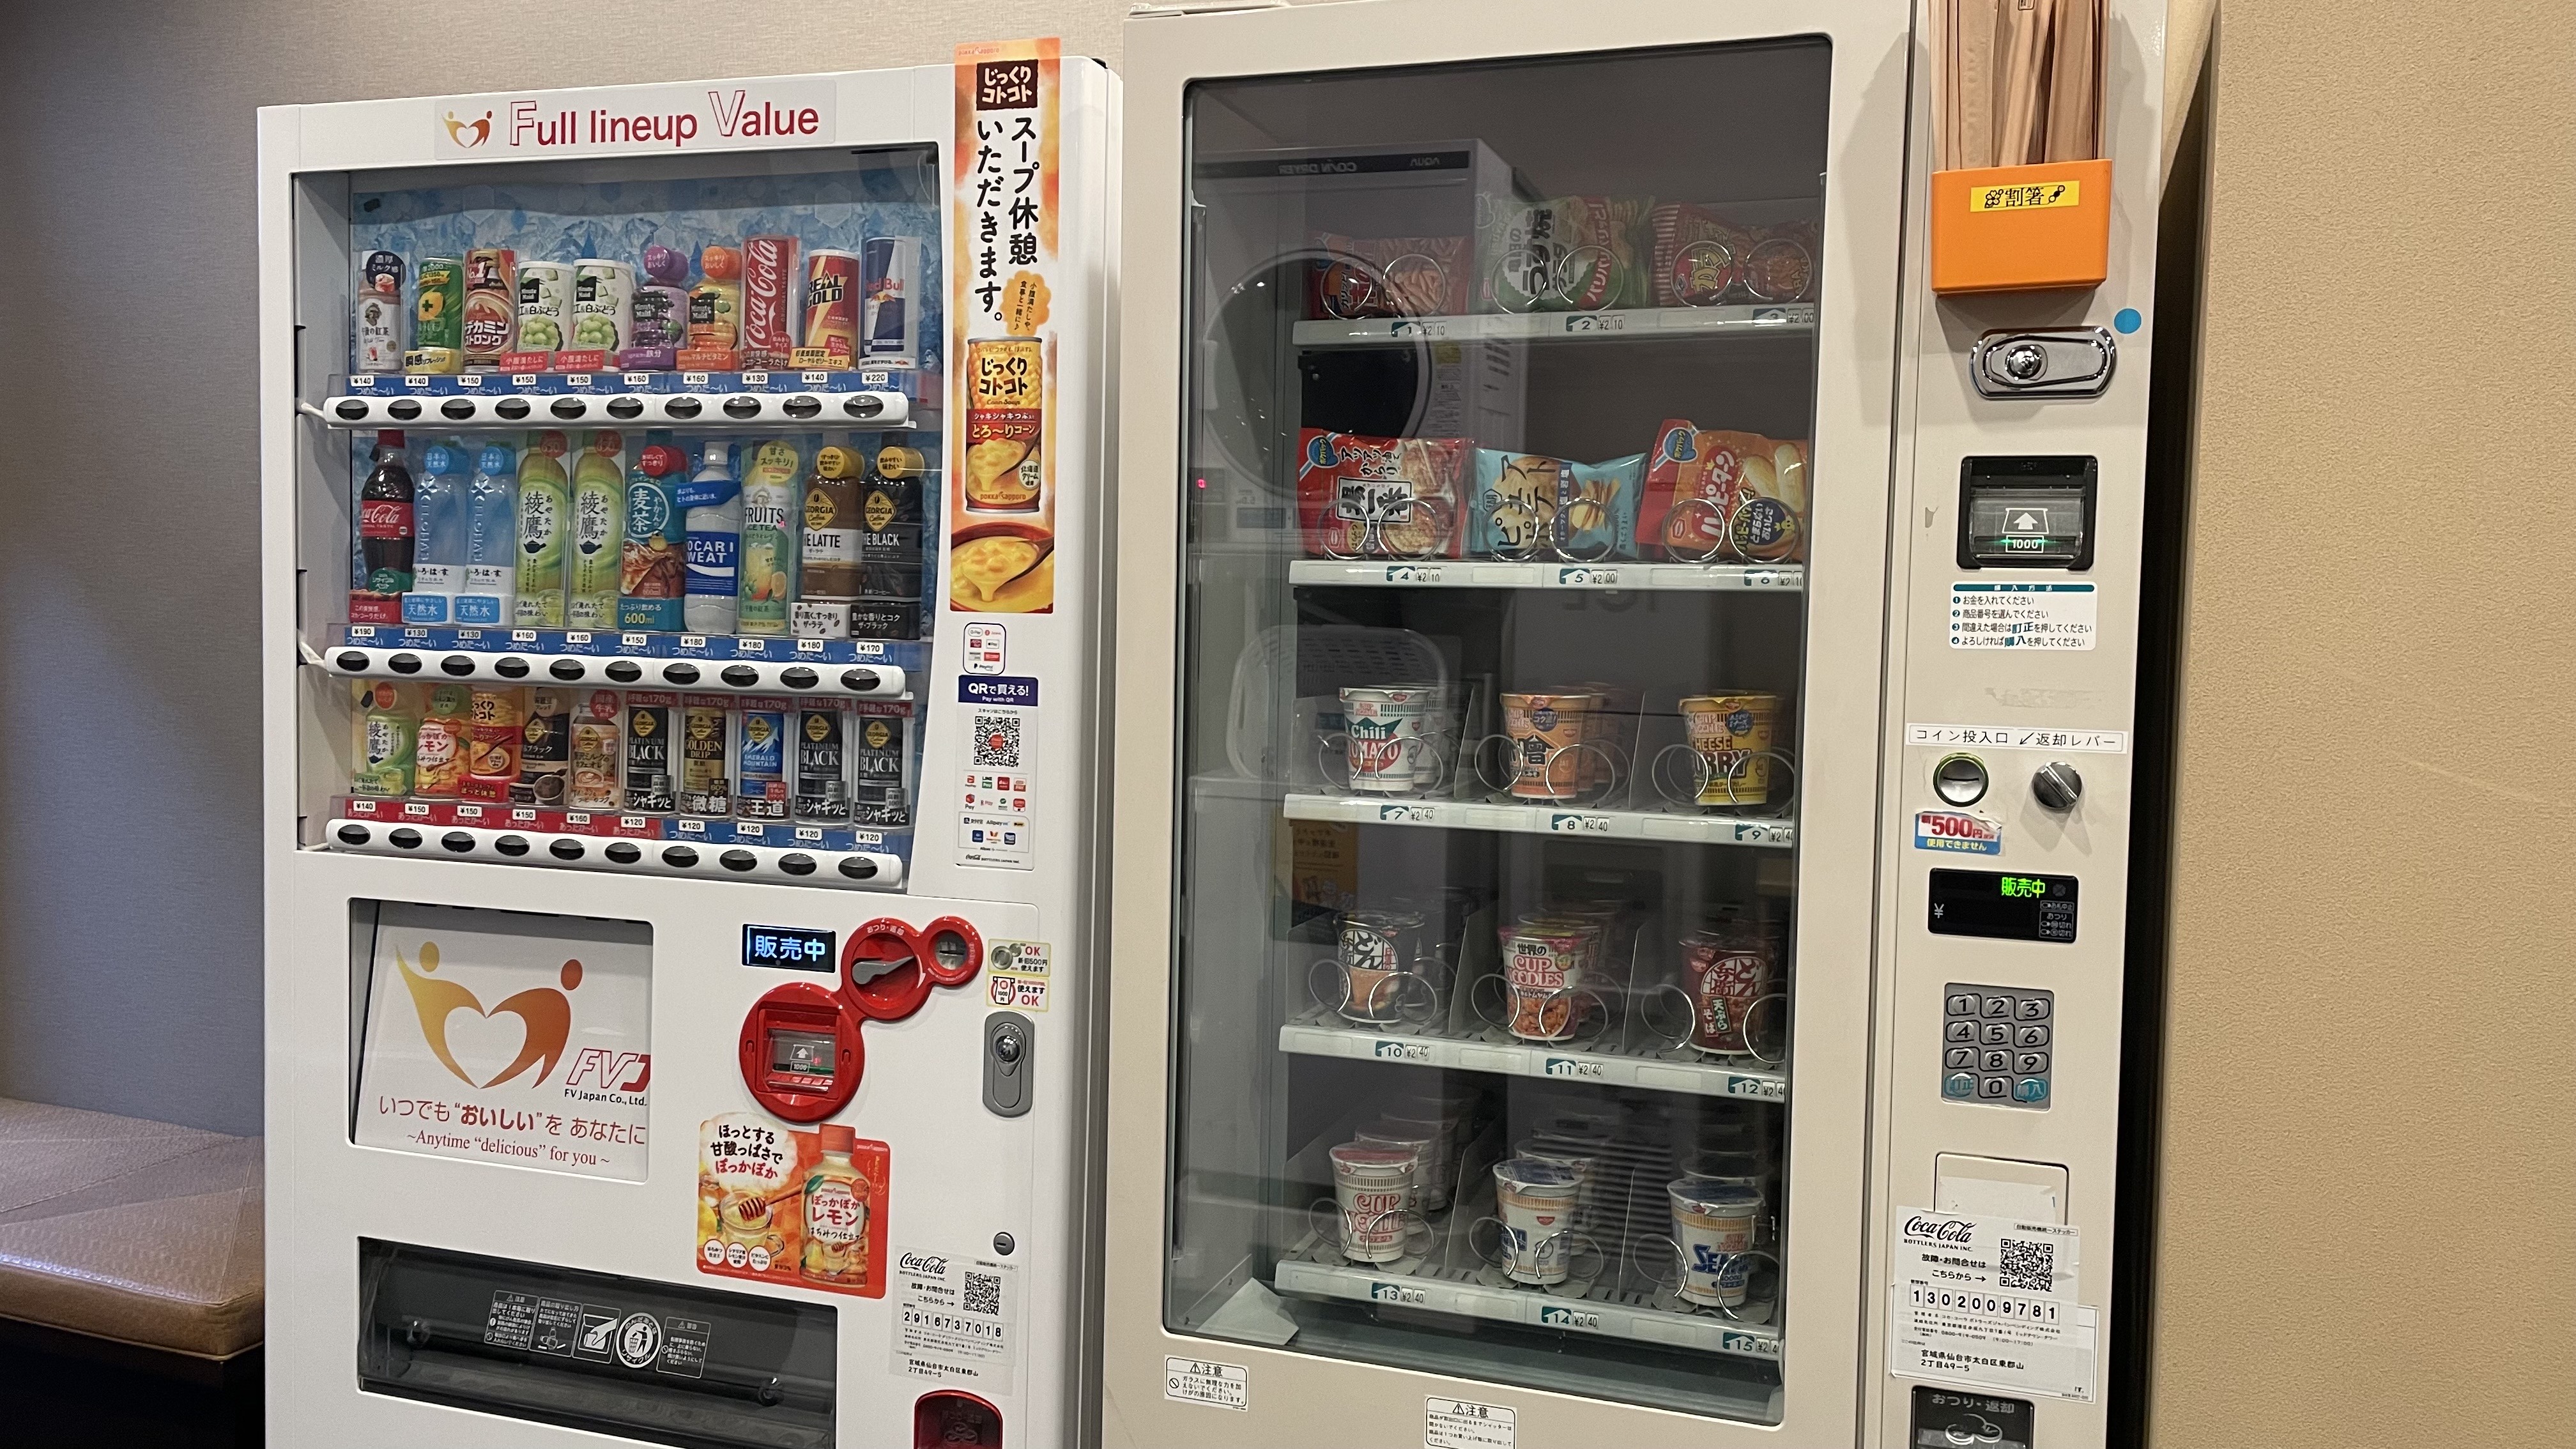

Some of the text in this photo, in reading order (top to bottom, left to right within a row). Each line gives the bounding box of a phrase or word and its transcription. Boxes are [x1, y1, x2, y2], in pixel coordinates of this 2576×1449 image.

[984, 66, 1032, 86] じっくり
[981, 84, 1032, 104] コトコト
[509, 89, 820, 148] Full lineup Value
[1008, 116, 1040, 265] スープ休憩
[2005, 187, 2044, 207] 割箸
[974, 120, 1004, 322] いただきます。
[808, 273, 843, 291] REAL
[746, 240, 778, 349] Coca-Cola
[981, 356, 1028, 376] じっくり
[461, 376, 479, 385] ¥150
[804, 373, 825, 381] ¥140
[978, 376, 1029, 396] コトコト
[524, 490, 544, 540] 綾鷹
[544, 495, 553, 537] あやたか
[580, 491, 601, 540] 綾鷹
[599, 496, 608, 537] あやたか
[632, 488, 651, 532] 麦茶
[813, 534, 841, 548] LATTE
[872, 533, 900, 546] BLACK
[2012, 538, 2039, 549] 1000
[1963, 595, 2035, 606] お金を入れてください
[408, 605, 438, 617] 天然水
[460, 605, 490, 617] 天然水
[1962, 609, 2049, 619] 商品番号を選んでください
[968, 682, 1029, 696] QRで買える!
[1351, 724, 1386, 741] Chili
[1917, 729, 2117, 747] コイン投入口 返却レバー
[628, 745, 664, 760] BLACK
[685, 740, 723, 751] GOLDEN
[800, 749, 839, 766] BLACK
[859, 756, 900, 773] BLACK
[633, 793, 671, 809] シャキッと
[692, 795, 726, 813] 微糖
[750, 799, 785, 816] 王道
[806, 800, 846, 816] シャキッと
[866, 806, 906, 823] シャキッと
[1394, 810, 1404, 820] 7
[740, 825, 760, 833] ¥120
[799, 830, 818, 838] ¥120
[1567, 820, 1576, 831] 8
[859, 833, 880, 841] ¥120
[1926, 838, 1988, 852] 使用できません
[2001, 877, 2046, 899] 販売中
[2046, 912, 2067, 921] おつり
[754, 935, 826, 962] 販売中
[1025, 946, 1041, 956] OK
[1517, 943, 1547, 956] 世界の
[1514, 955, 1552, 972] CUP
[1506, 966, 1565, 988] NOODLES
[1017, 985, 1046, 994] 使えます
[1021, 994, 1039, 1007] OK
[1959, 998, 2039, 1017] 1 2 3
[1703, 1008, 1716, 1034] そば
[1712, 999, 1728, 1031] 天ぷら
[1956, 1024, 2039, 1044] 4 5 6
[1387, 1046, 1403, 1059] 10
[1956, 1050, 2038, 1071] 7 8 9
[1558, 1064, 1572, 1075] 11
[1988, 1080, 2003, 1094] 0
[564, 1089, 648, 1107] FV Japan Co., Ltd.
[570, 1117, 647, 1146] あなたに
[718, 1124, 775, 1145] ほっとする
[549, 1146, 569, 1162] for
[571, 1151, 597, 1167] you
[710, 1140, 783, 1165] 甘酸っぱさで
[716, 1158, 779, 1180] ぽっかぽか
[811, 1195, 861, 1211] ぽっかぽか
[1354, 1193, 1400, 1215] CUP
[812, 1207, 859, 1227] レモン
[1903, 1215, 1977, 1244] Coca-Cola
[1903, 1238, 1938, 1248] BOTTLERS
[1938, 1243, 1959, 1251] JAPAN
[900, 1252, 950, 1275] Coca-Cola
[1921, 1253, 1987, 1269] 故障・お問合せは
[1931, 1269, 1972, 1282] こちらから
[917, 1295, 946, 1306] こちらから
[1382, 1289, 1399, 1301] 13
[1554, 1313, 1570, 1325] 14
[621, 1348, 652, 1365] リサイクル
[1920, 1348, 2025, 1370] 宮城県仙台市太白区東郡山
[1201, 1363, 1223, 1378] 注意
[1466, 1404, 1489, 1419] 注意
[1931, 1393, 2015, 1414] おつり・返却
